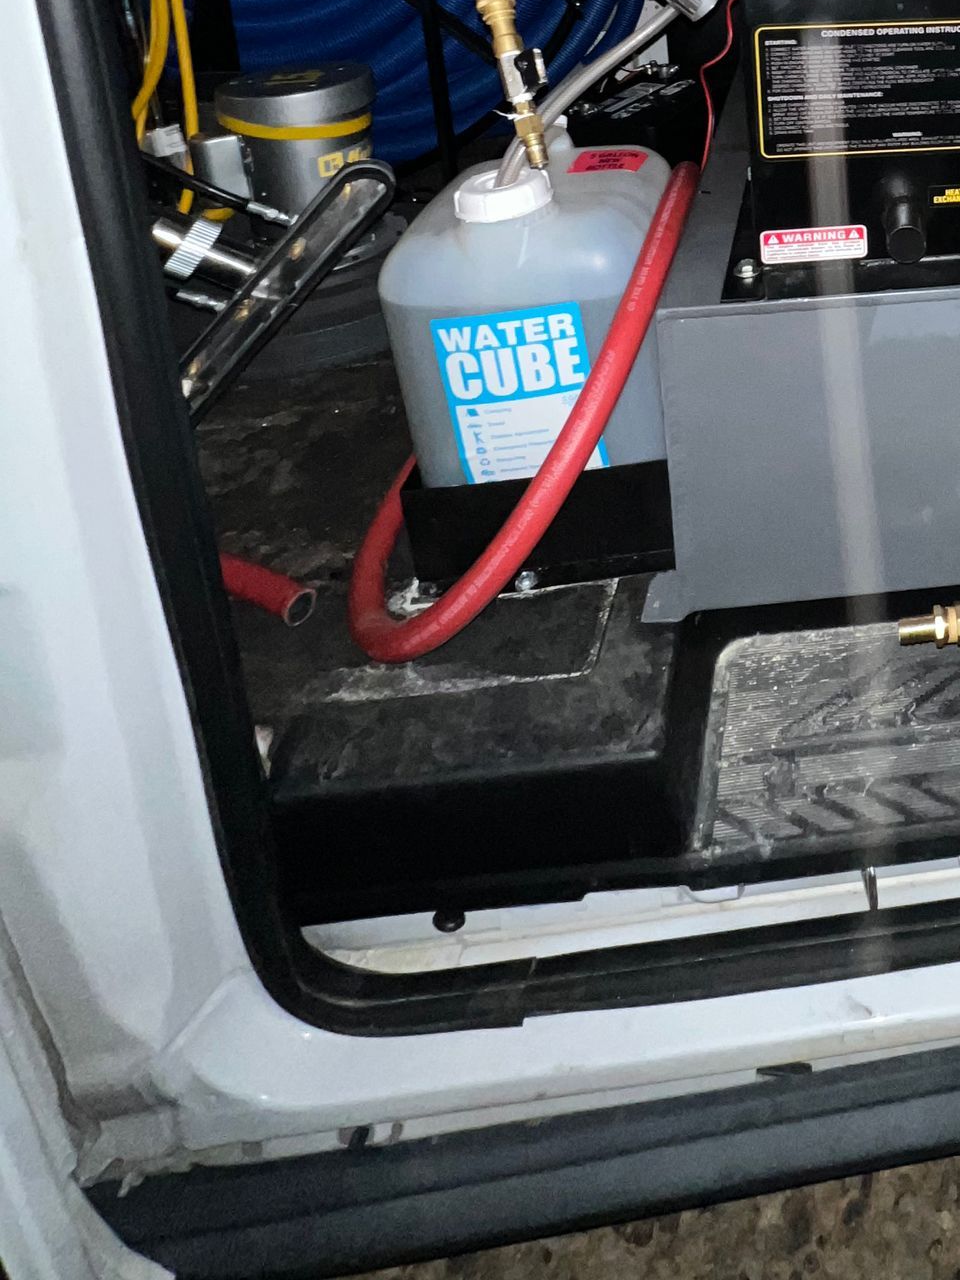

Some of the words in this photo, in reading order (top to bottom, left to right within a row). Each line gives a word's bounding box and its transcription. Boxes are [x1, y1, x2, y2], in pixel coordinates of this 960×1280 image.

[821, 27, 875, 37] CONDENSED
[876, 26, 925, 36] OPERATING
[781, 230, 846, 243] WARNING
[437, 313, 577, 352] WATER
[445, 337, 586, 401] CUBE
